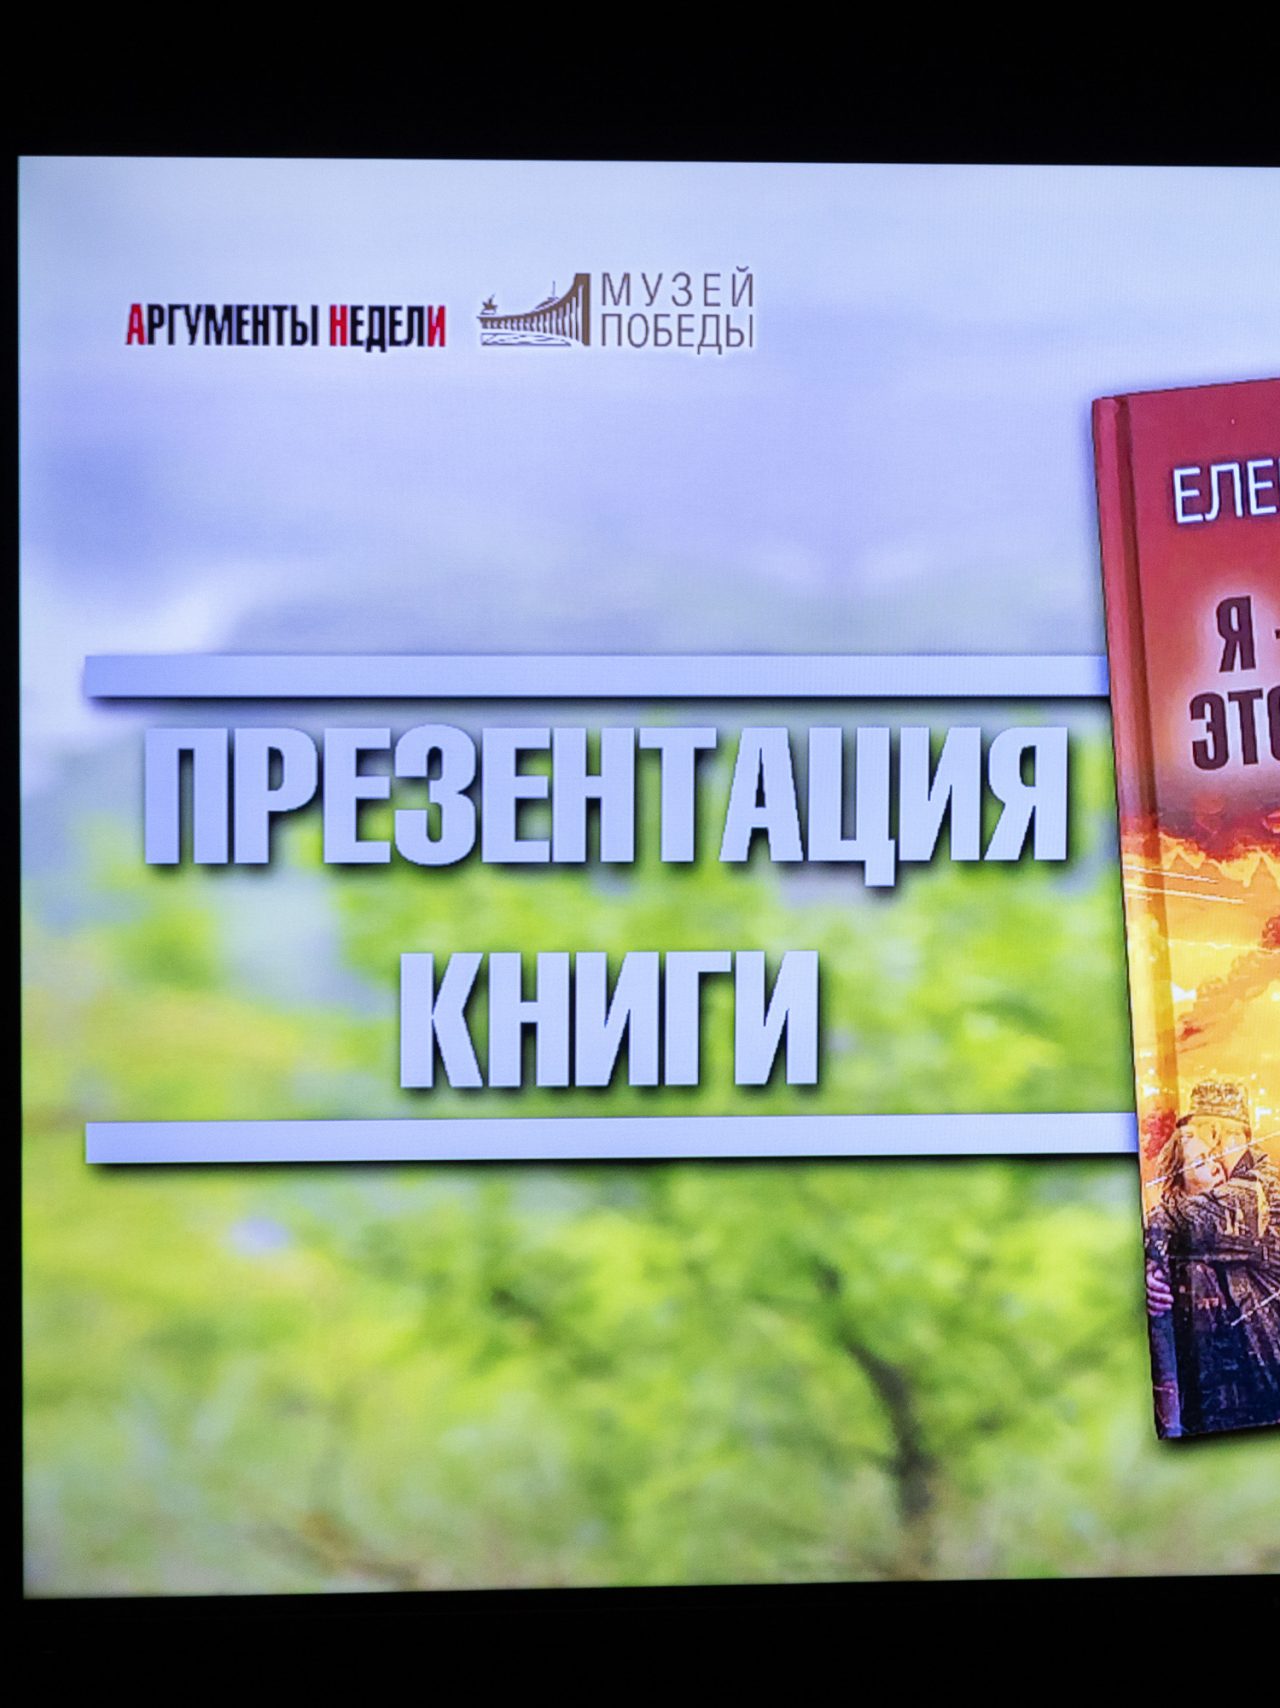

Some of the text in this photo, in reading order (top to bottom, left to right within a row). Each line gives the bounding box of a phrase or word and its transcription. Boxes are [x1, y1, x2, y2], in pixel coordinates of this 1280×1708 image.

[602, 265, 754, 307] МУЗЕЙ
[126, 303, 446, 353] АРГУМЕНТЫ НЕДЕЛИ
[601, 313, 753, 355] ПОБЕДЫ
[1216, 595, 1257, 673] Я
[145, 723, 1068, 887] ПРЕЗЕНТАЦИЯ
[400, 950, 818, 1088] КНИГИ
